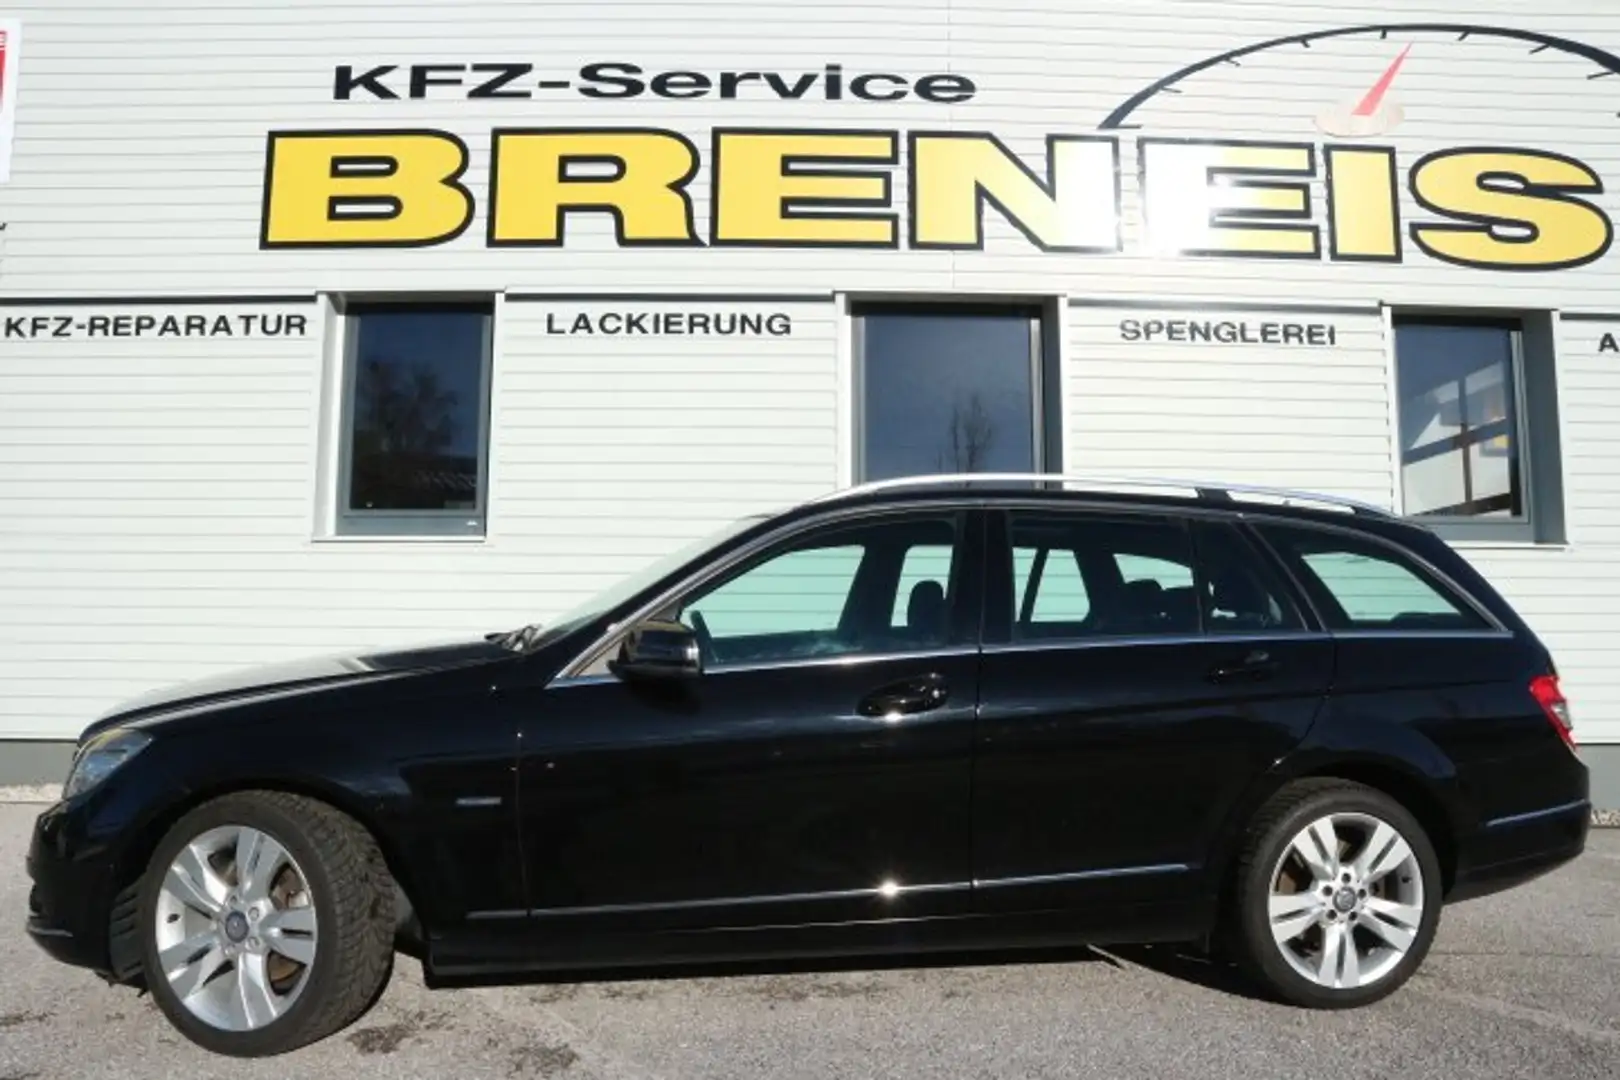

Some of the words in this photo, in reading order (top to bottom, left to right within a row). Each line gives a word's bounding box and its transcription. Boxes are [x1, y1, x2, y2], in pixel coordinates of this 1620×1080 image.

[333, 62, 976, 104] KFZ-Service
[259, 127, 1614, 272] BRENEIS
[5, 314, 307, 338] KFZ-REPARATUR
[547, 312, 791, 336] LACKIERUNG
[1120, 319, 1336, 346] SPENGLEREI
